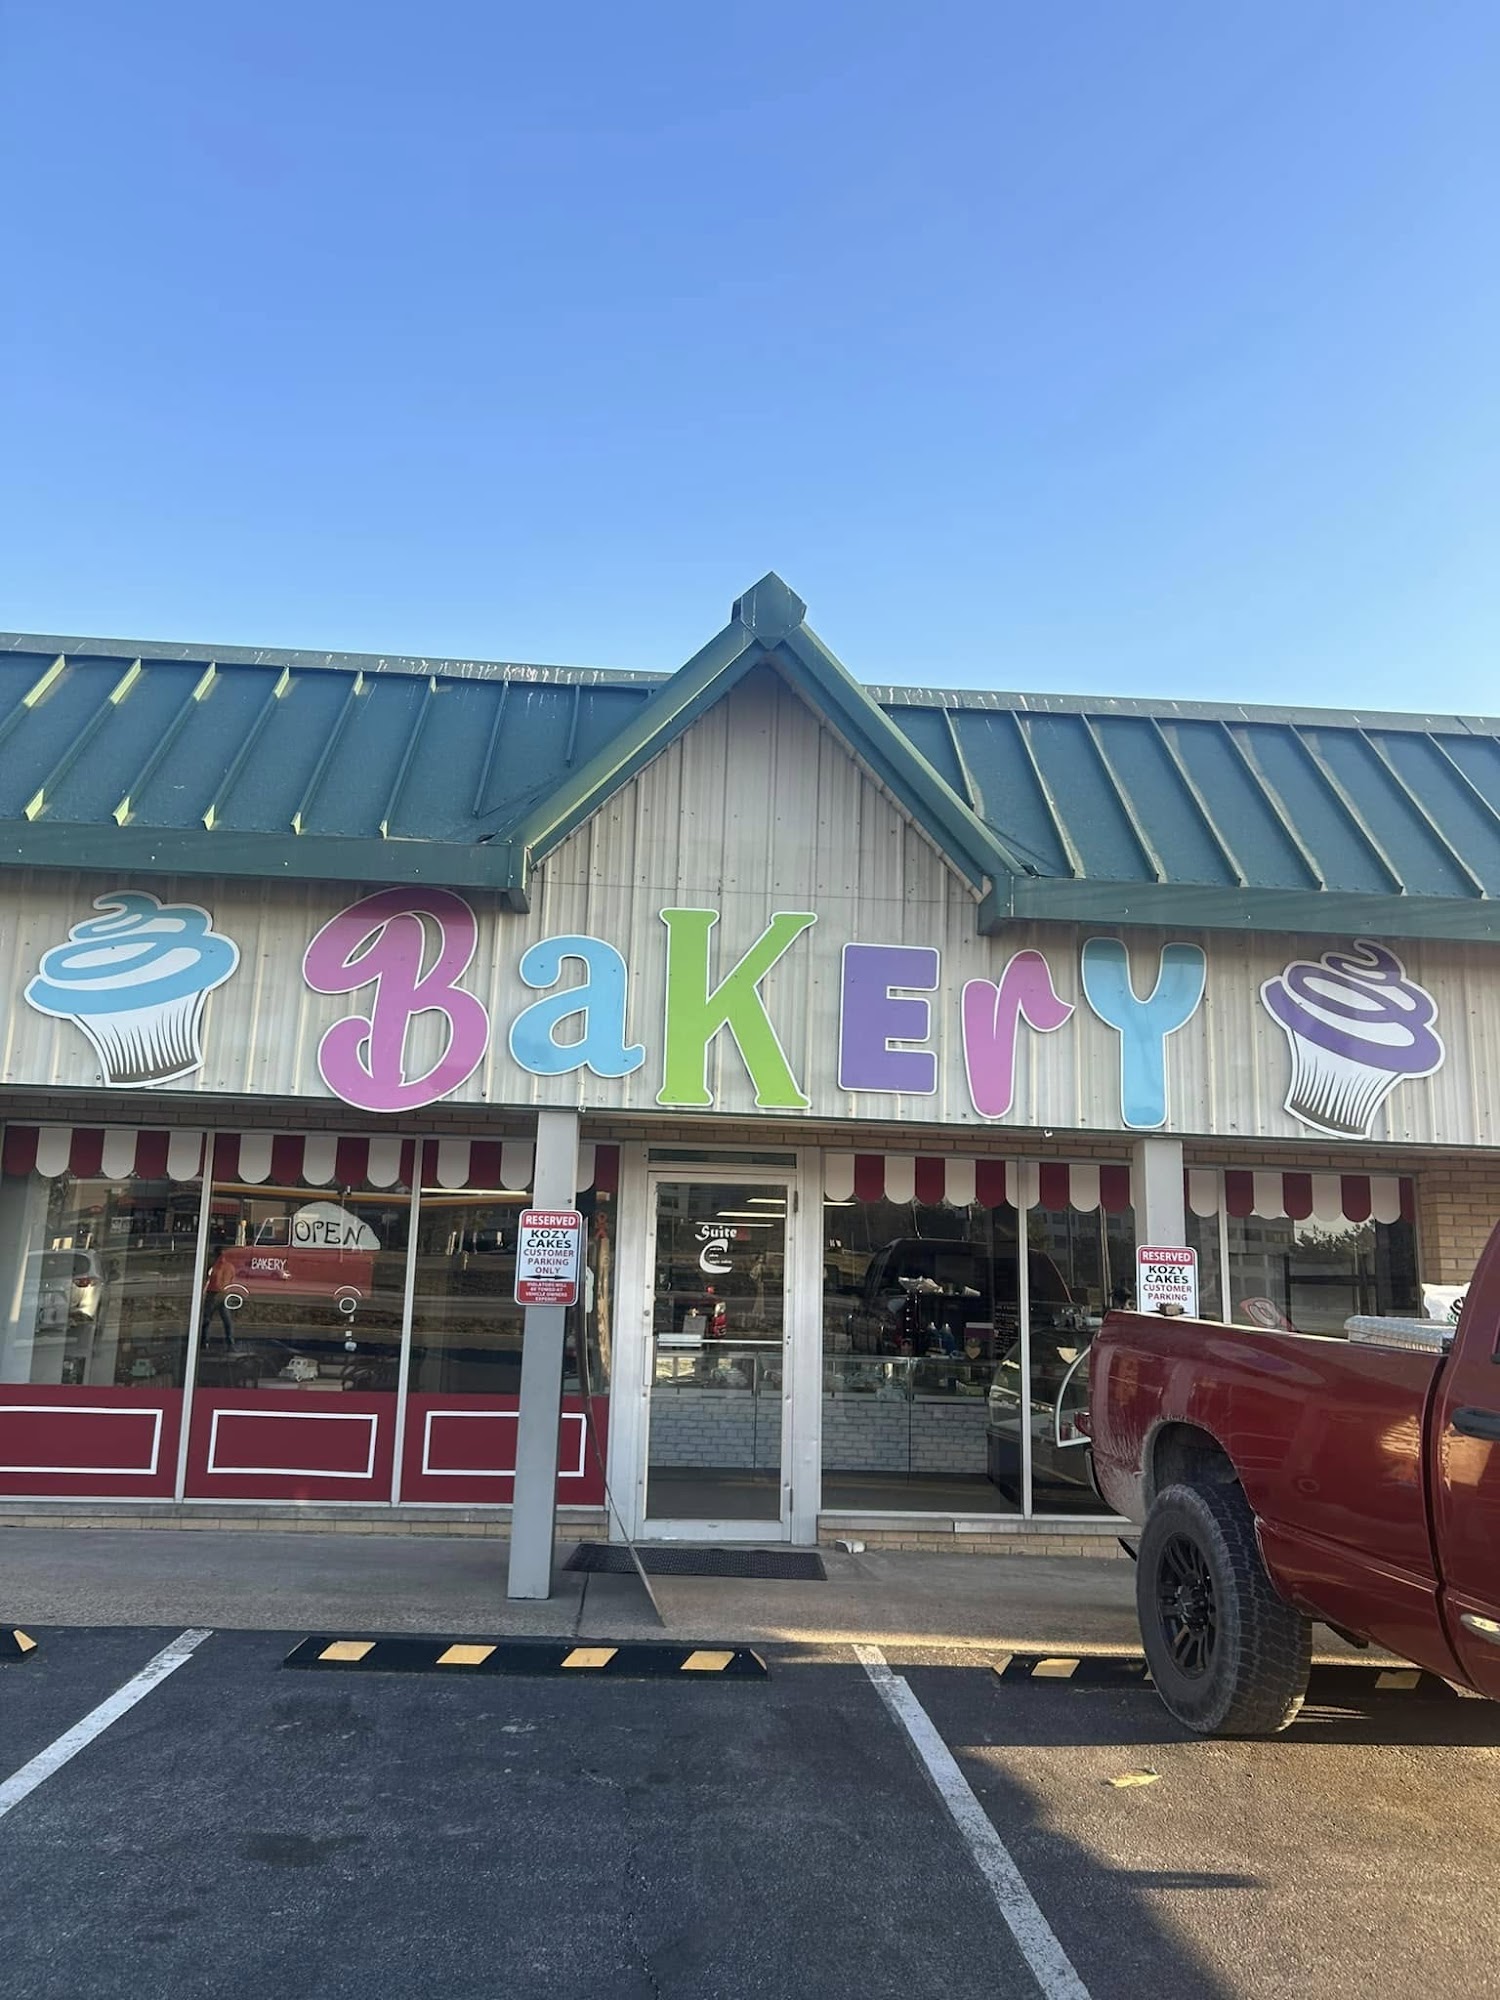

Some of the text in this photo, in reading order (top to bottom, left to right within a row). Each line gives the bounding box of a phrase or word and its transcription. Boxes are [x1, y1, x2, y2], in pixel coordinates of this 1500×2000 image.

[525, 1215, 576, 1226] RESERVED
[295, 1220, 366, 1245] OPEN
[531, 1230, 569, 1239] KOZY
[694, 1225, 738, 1241] Suite
[527, 1239, 572, 1249] CAKES
[523, 1249, 574, 1257] CUSTOMER
[1142, 1251, 1191, 1262] RESERVED
[251, 1257, 287, 1271] BAKERY
[527, 1258, 569, 1266] PARKING
[535, 1267, 561, 1275] ONLY
[1148, 1265, 1185, 1275] KOZY
[1145, 1274, 1189, 1284] CAKES
[1143, 1284, 1192, 1293] CUSTOMER
[1147, 1292, 1188, 1301] PARKING
